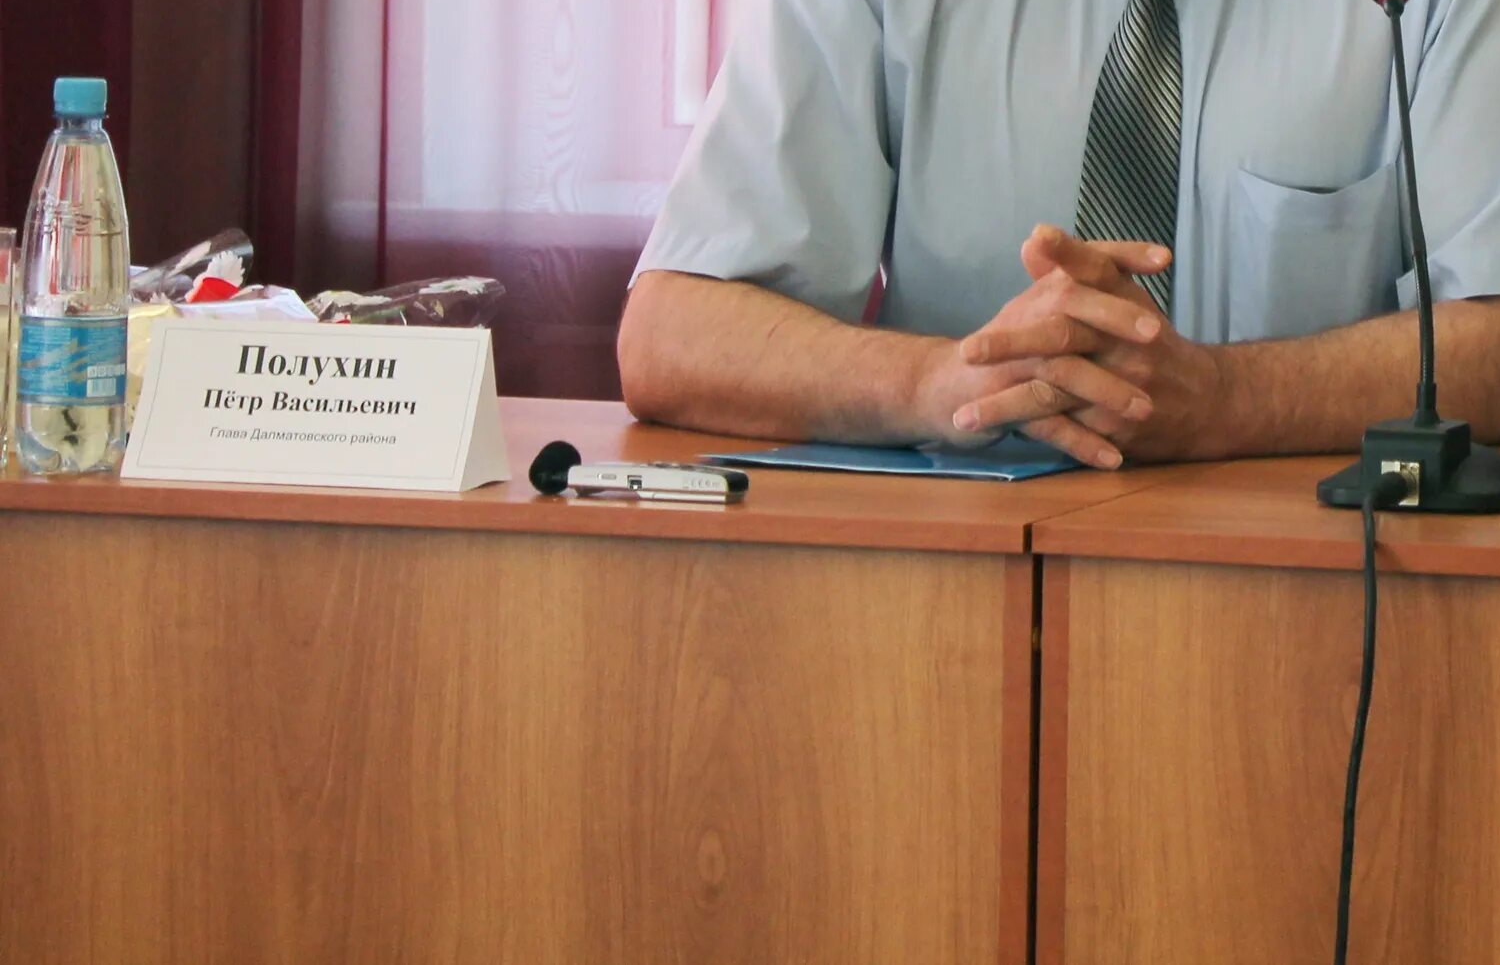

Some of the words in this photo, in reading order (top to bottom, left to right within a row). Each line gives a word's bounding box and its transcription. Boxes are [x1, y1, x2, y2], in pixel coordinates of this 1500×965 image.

[236, 344, 398, 385] Полухин
[203, 388, 263, 415] Пётр
[271, 391, 417, 415] Васильевич
[209, 426, 248, 440] Глава
[250, 428, 347, 443] Далматовского
[349, 432, 397, 446] района
